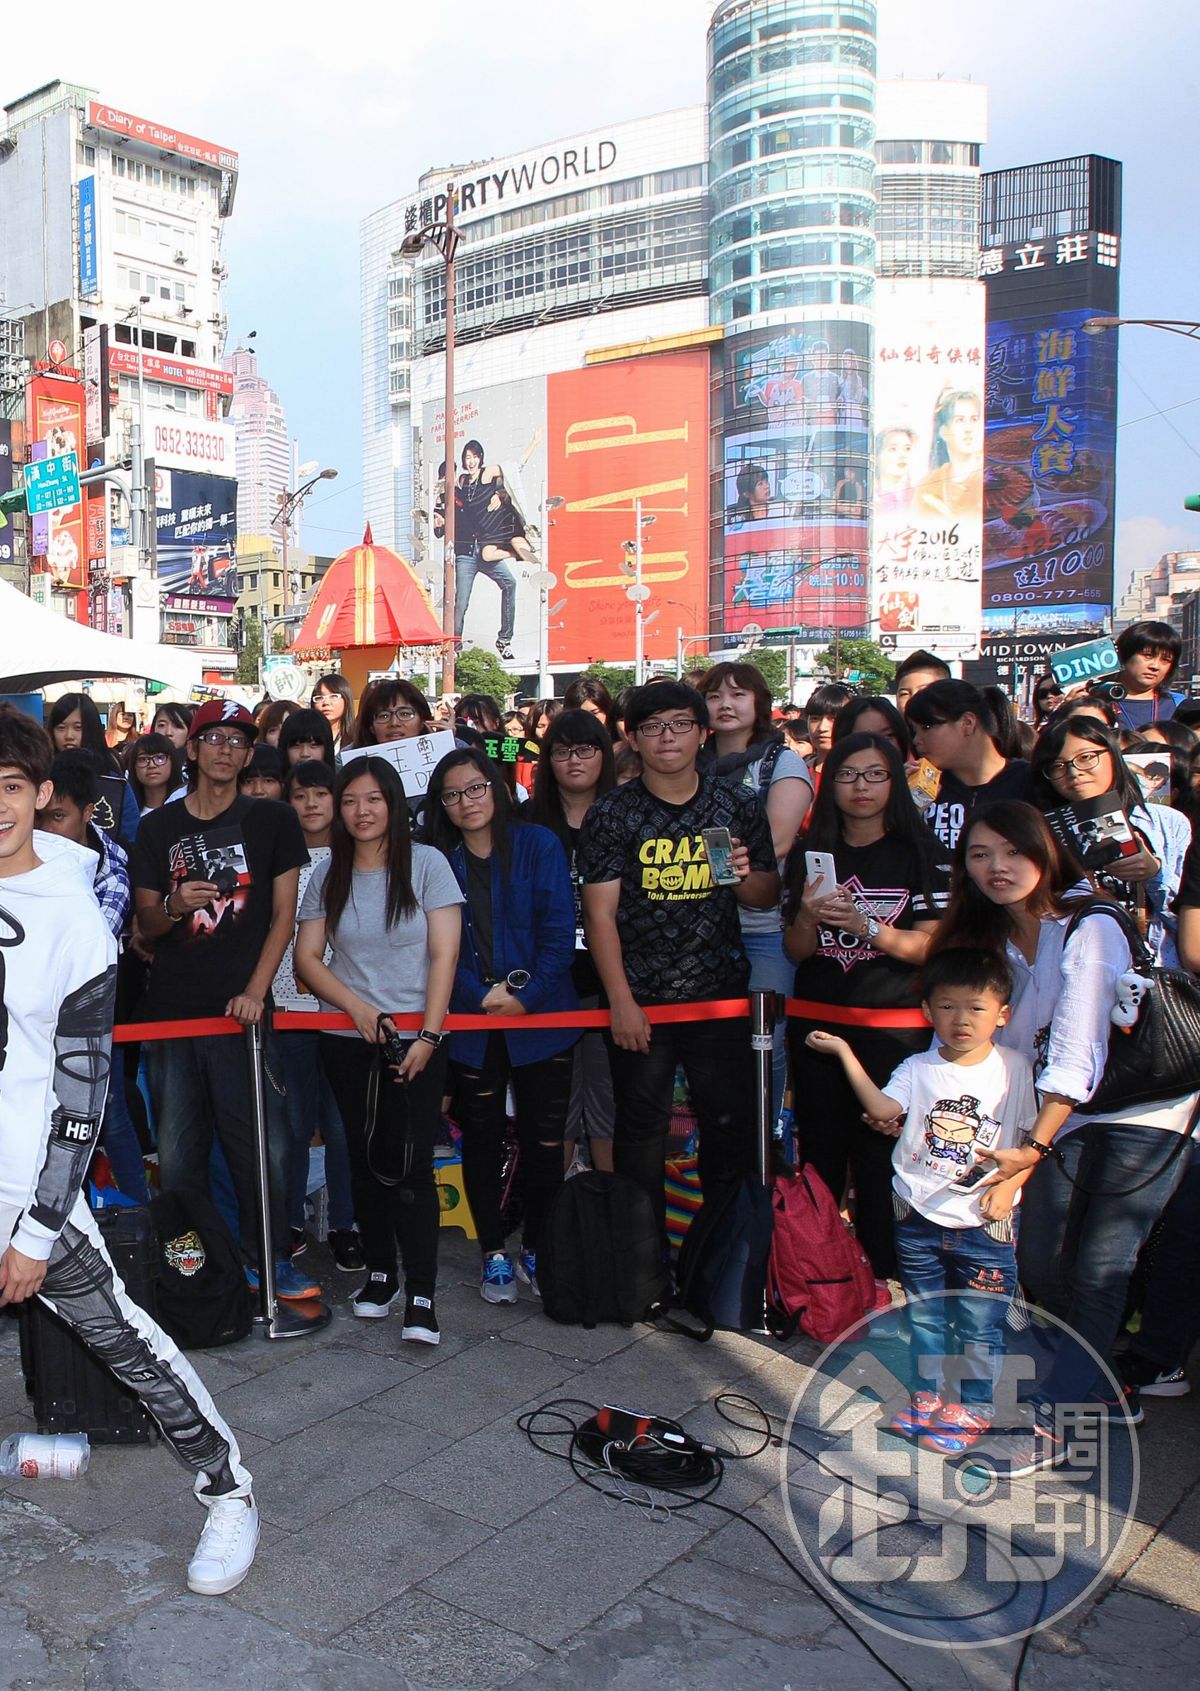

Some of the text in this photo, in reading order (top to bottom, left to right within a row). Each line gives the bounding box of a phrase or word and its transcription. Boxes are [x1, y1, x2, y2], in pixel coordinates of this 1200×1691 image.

[107, 110, 177, 144] Diary of Taipei
[880, 344, 981, 366] 仙劍奇俠傳
[163, 365, 184, 377] HOTEL
[30, 455, 72, 482] 漢中街
[565, 415, 689, 590] GAP
[917, 523, 960, 546] 2016
[979, 643, 1067, 657] MIDTOWN
[1053, 650, 1119, 683] DINO
[275, 674, 295, 693] 帥
[180, 837, 198, 870] LUCY
[194, 834, 207, 857] MR.
[639, 836, 708, 865] CRAZ
[642, 862, 716, 890] BOM
[647, 892, 666, 901] 10th
